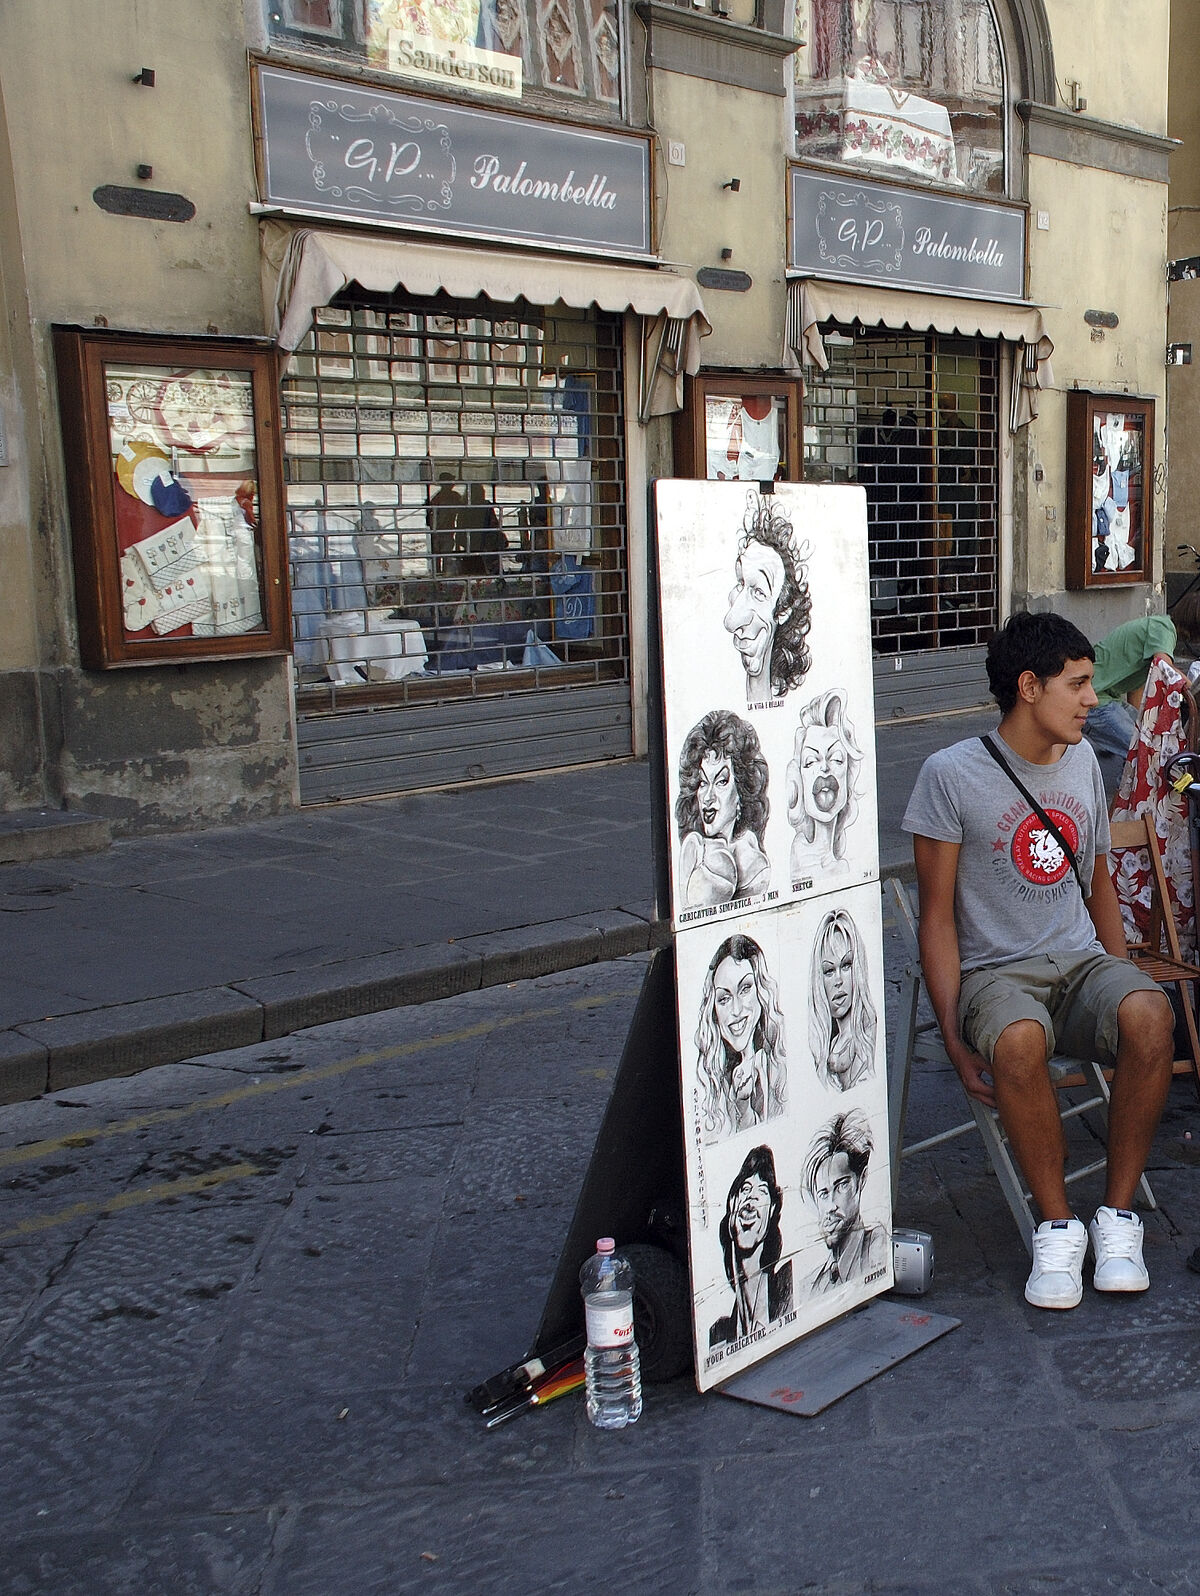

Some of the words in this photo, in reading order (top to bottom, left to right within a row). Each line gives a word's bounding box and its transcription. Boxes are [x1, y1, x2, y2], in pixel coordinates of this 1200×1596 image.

[397, 39, 516, 89] Sanderson
[469, 153, 618, 211] Palombella
[912, 225, 1004, 268] Palombella
[1039, 791, 1087, 825] NATIONAL
[678, 905, 718, 924] CARICATURA
[718, 897, 752, 914] SIMPATICA
[864, 1266, 888, 1285] CARTOON
[705, 1353, 724, 1368] YOUR
[725, 1327, 767, 1356] CARICATURE
[784, 1309, 798, 1325] MIN
